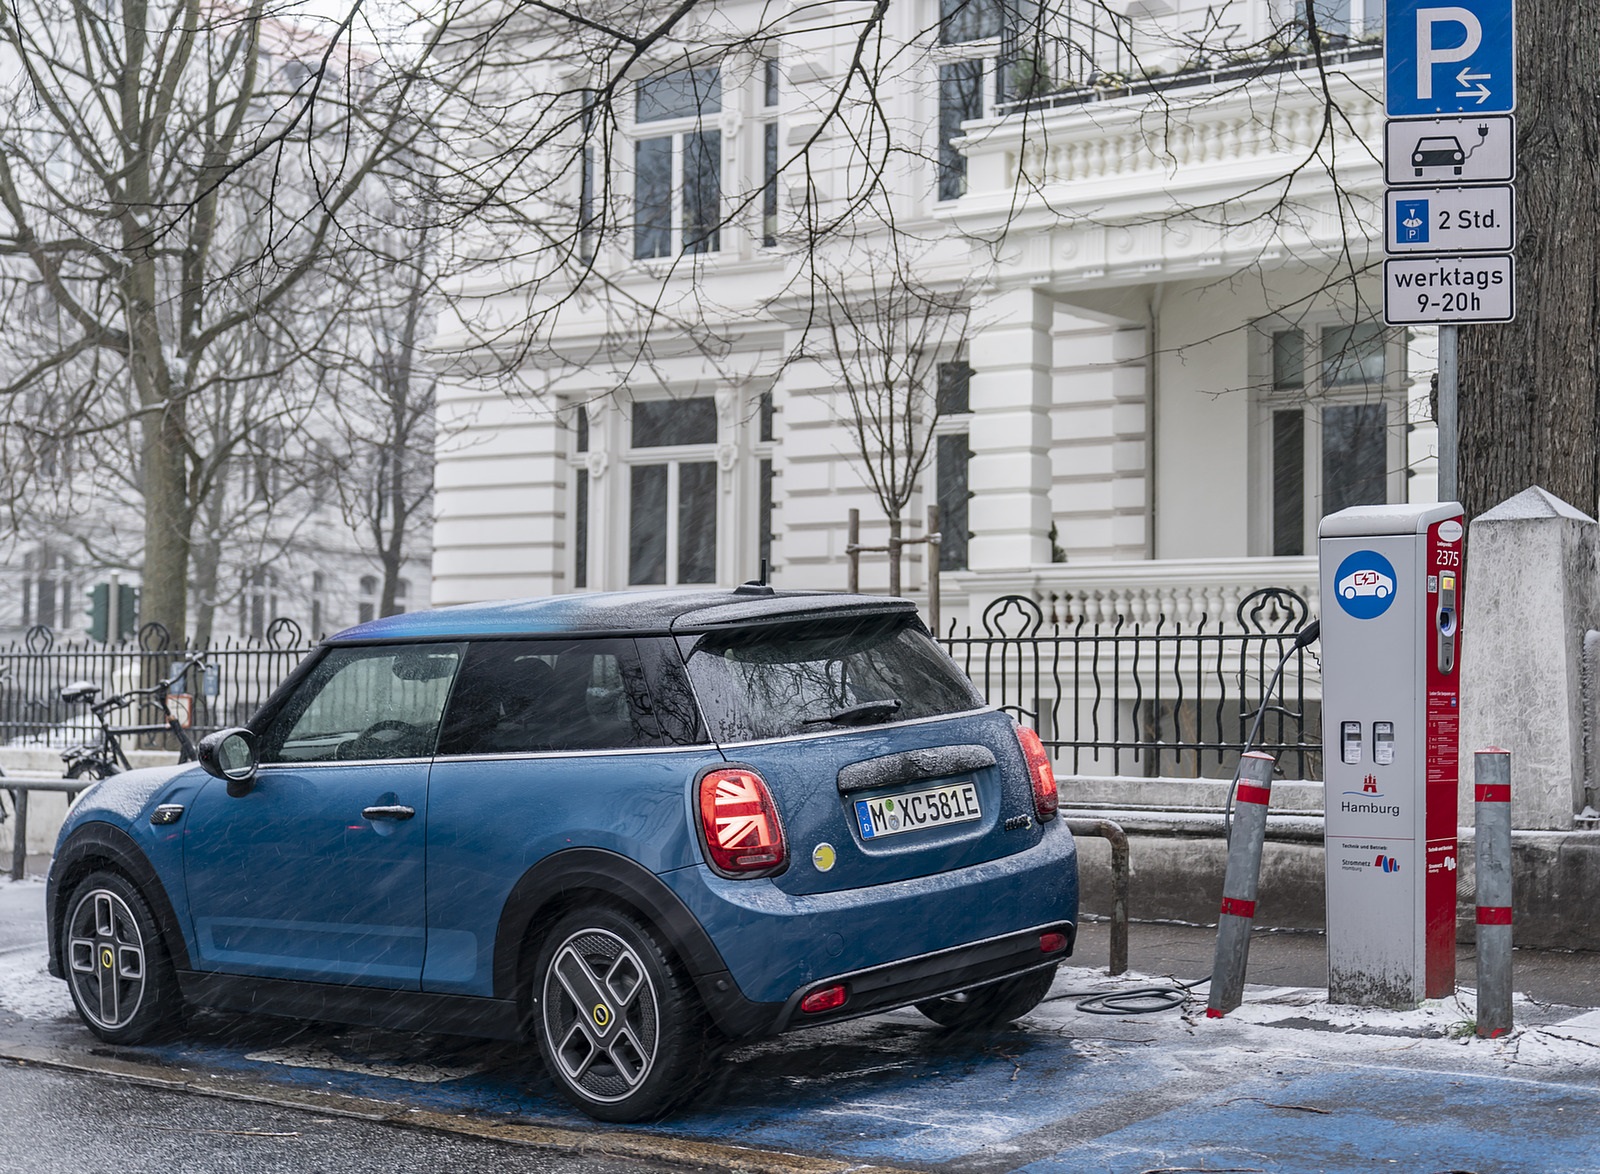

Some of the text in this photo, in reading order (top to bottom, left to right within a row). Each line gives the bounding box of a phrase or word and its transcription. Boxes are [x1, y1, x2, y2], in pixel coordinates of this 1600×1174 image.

[1416, 6, 1483, 100] P
[1438, 208, 1501, 230] 2 Std.
[1409, 229, 1417, 239] P
[1394, 267, 1504, 290] werktags
[1436, 549, 1459, 567] 2375
[869, 803, 888, 832] M
[1341, 801, 1400, 817] Hamburg
[864, 823, 870, 832] D
[1342, 859, 1371, 867] Stromnetz
